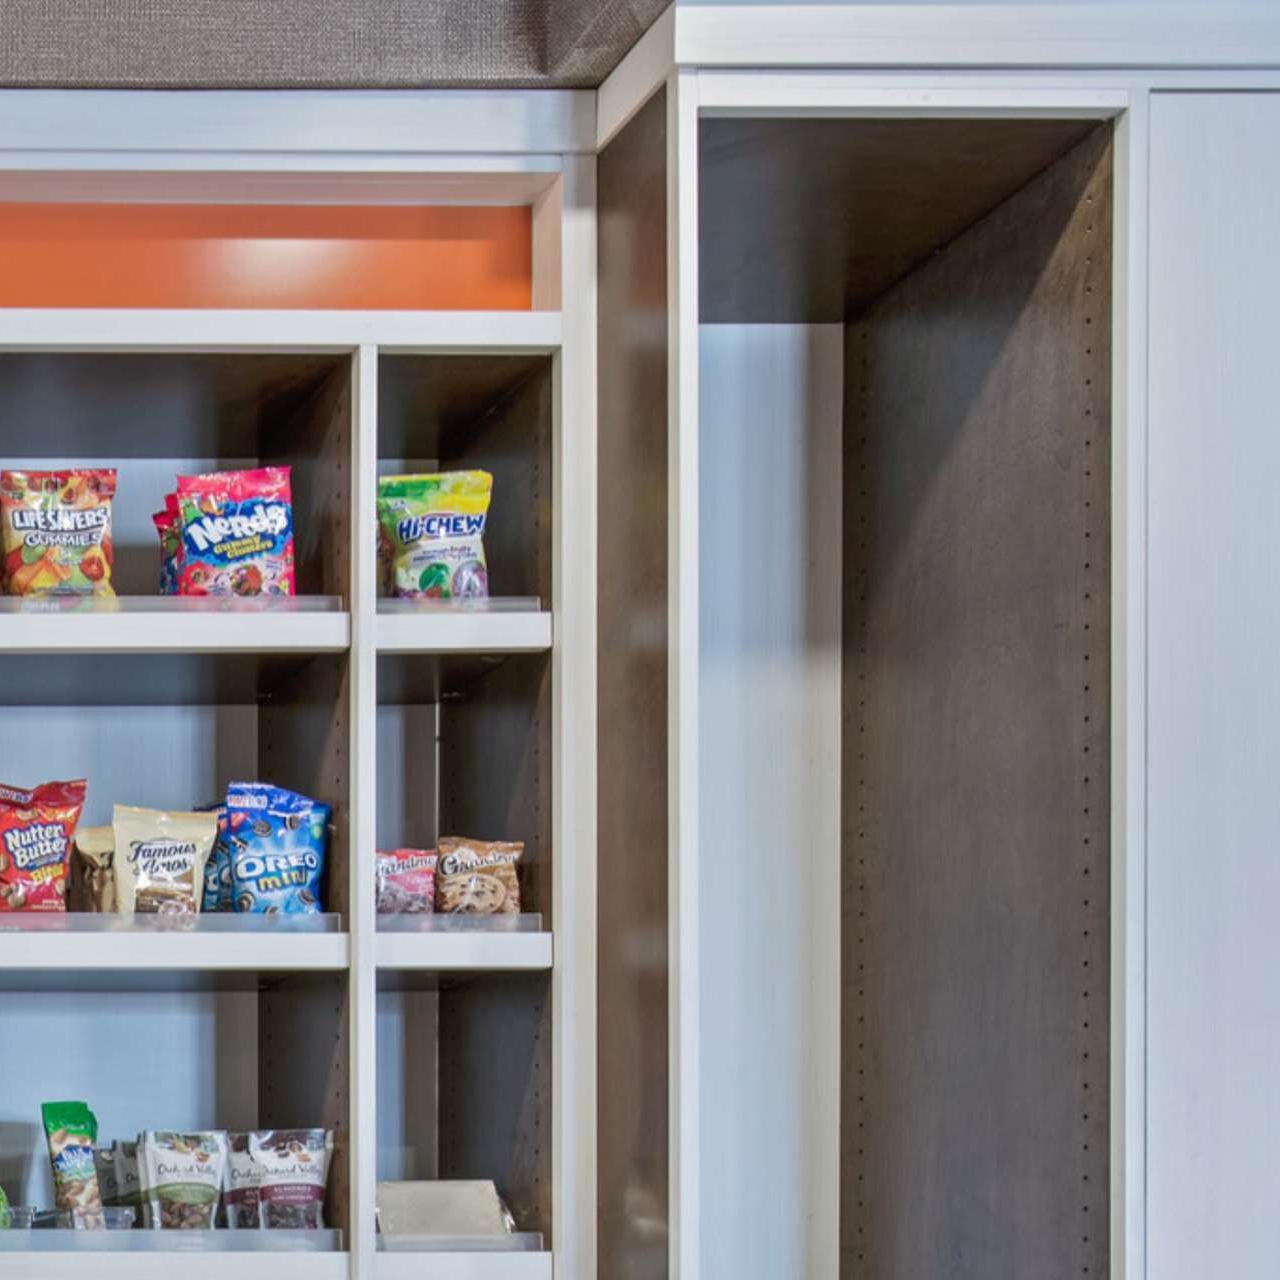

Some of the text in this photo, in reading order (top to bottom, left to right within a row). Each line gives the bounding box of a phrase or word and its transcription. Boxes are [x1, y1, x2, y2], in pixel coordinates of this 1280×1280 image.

[188, 504, 288, 551] Nerds
[398, 515, 485, 541] HI-CHEW
[5, 822, 64, 849] Nutter
[15, 839, 68, 869] Butter
[129, 840, 197, 862] Famous
[241, 853, 320, 877] OREO
